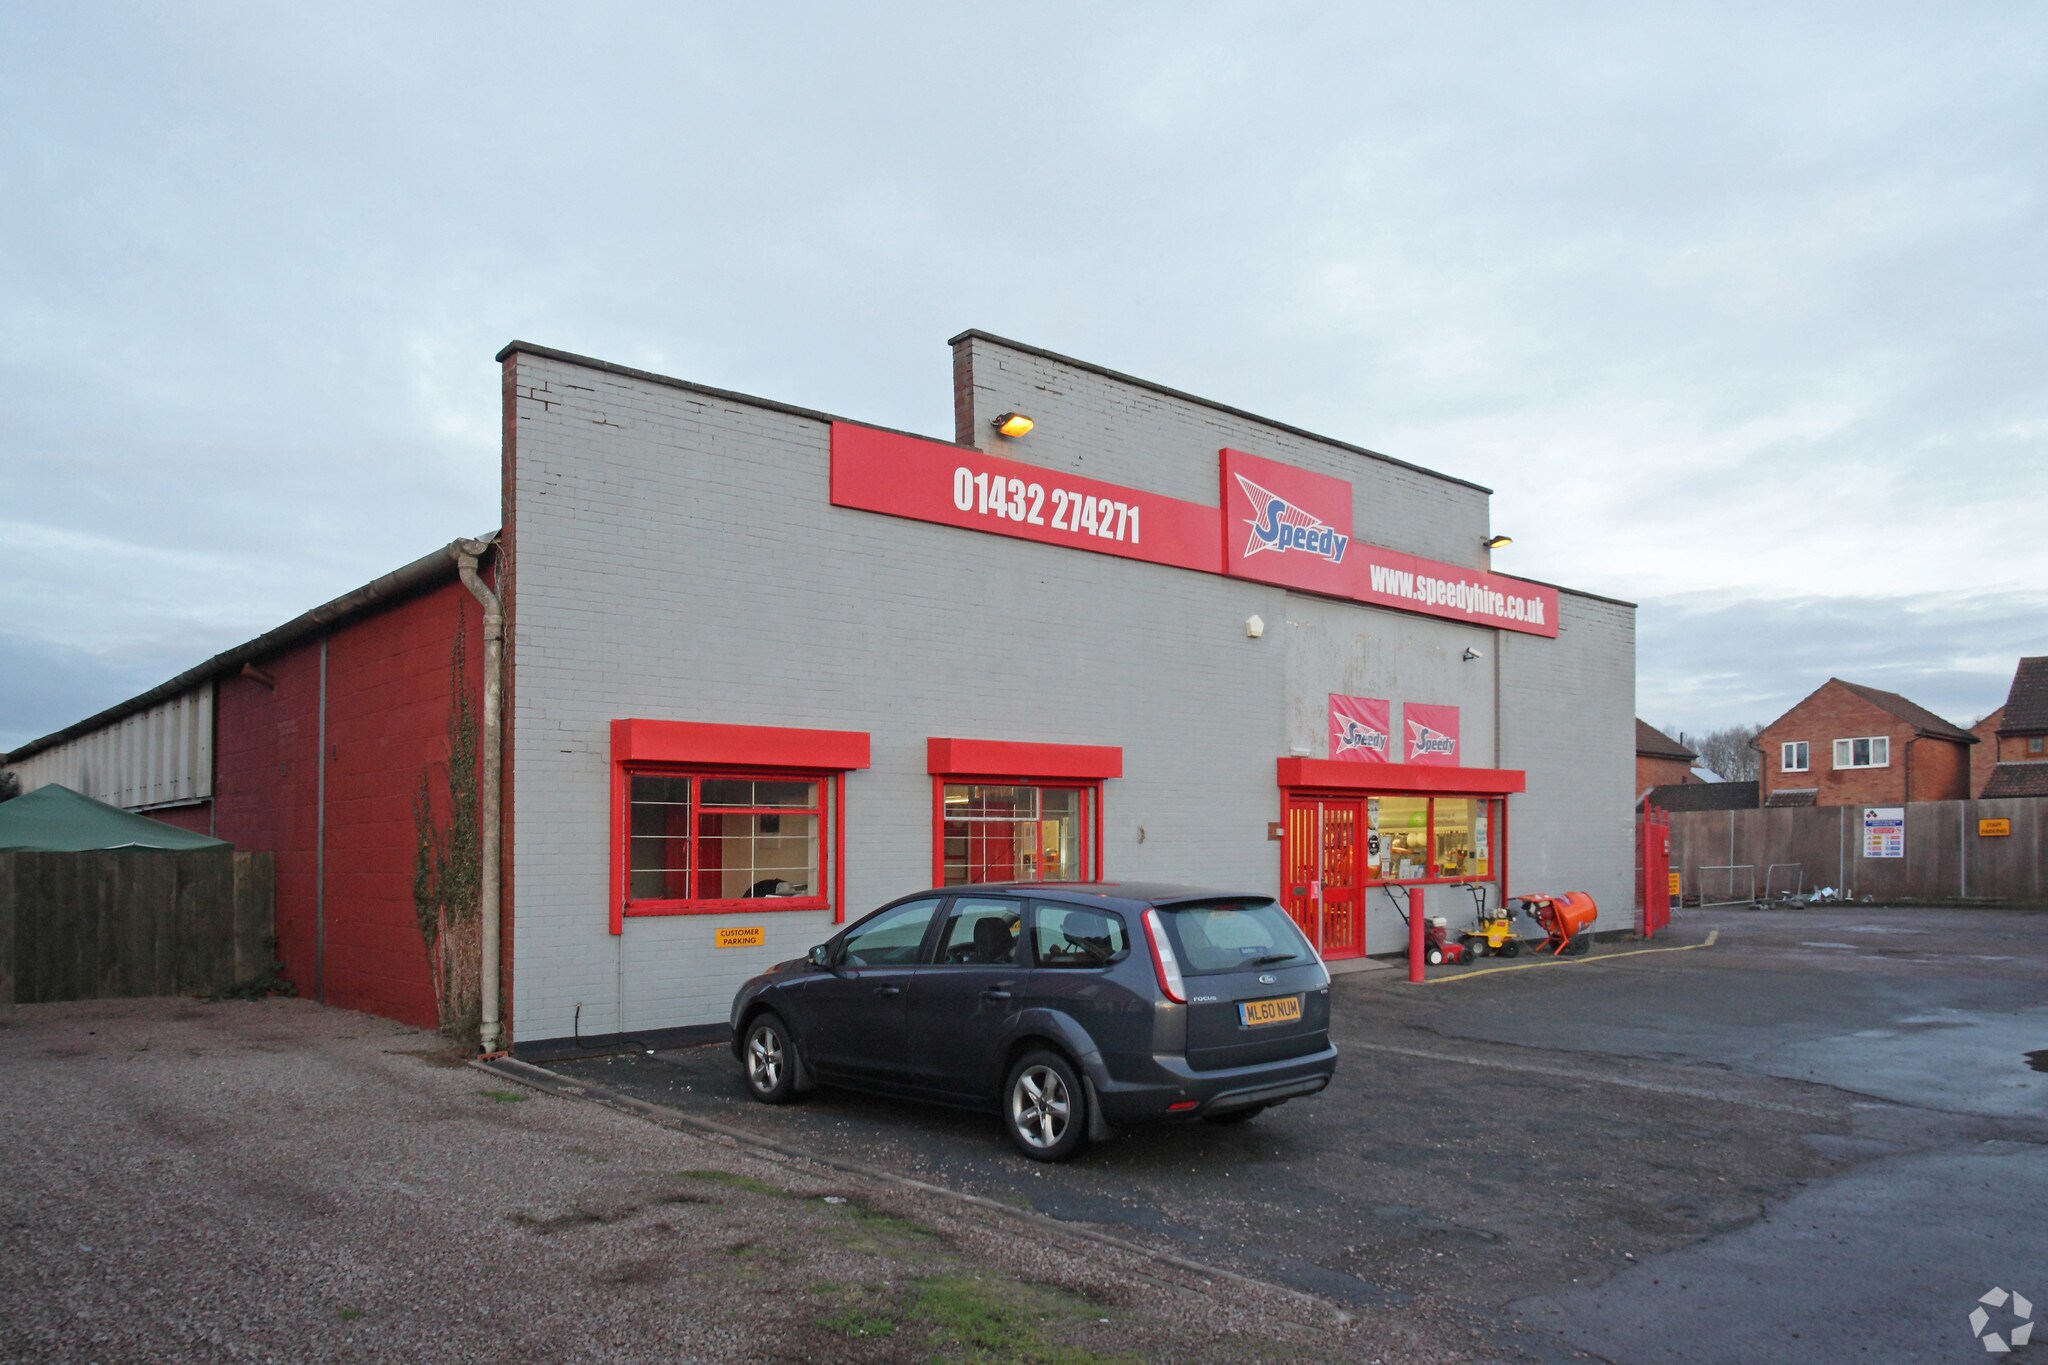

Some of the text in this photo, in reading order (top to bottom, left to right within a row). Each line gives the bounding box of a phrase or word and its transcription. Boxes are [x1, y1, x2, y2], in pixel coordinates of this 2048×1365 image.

[953, 467, 1140, 544] 01432 274271
[1254, 499, 1348, 563] Speedy
[1370, 564, 1545, 625] www.speedyhire.co.uk
[1342, 722, 1387, 751] Speedy
[1416, 728, 1455, 754] Speedy
[720, 929, 760, 937] CUSTOMER
[723, 937, 757, 945] PARKING
[1246, 1000, 1298, 1021] ML60 NUM
